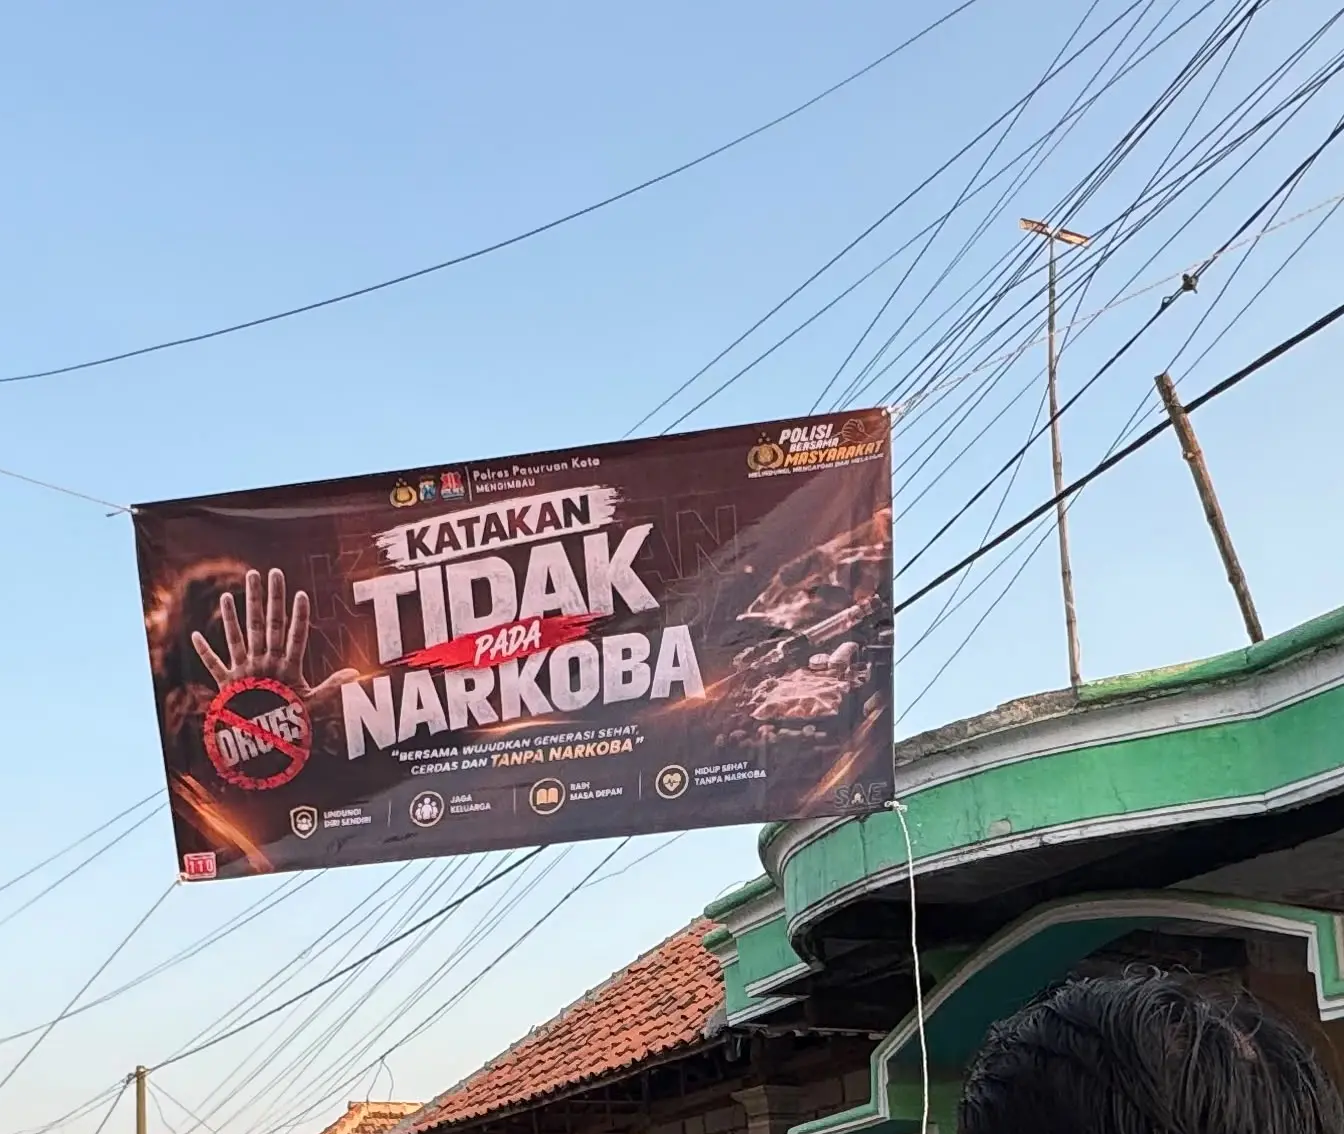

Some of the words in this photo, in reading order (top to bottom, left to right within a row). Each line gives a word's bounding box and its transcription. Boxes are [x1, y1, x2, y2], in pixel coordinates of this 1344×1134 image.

[779, 423, 834, 444] POLISI
[789, 437, 839, 452] BERSAMA
[784, 440, 884, 467] MASYARAKAT
[473, 466, 509, 482] Polres
[512, 461, 568, 476] Pasuruan
[571, 457, 601, 470] Kota
[476, 479, 536, 494] MENGIMBAU
[406, 495, 590, 560] KATAKAN
[353, 523, 660, 664] TIDAK
[474, 620, 542, 667] PADA
[341, 625, 706, 760] NARKOBA
[217, 702, 304, 767] DRUGS
[462, 740, 530, 755] WUJUDKAN
[534, 732, 595, 746] GENERASI
[411, 761, 458, 775] CERDAS
[461, 758, 487, 769] DAN
[491, 749, 544, 768] TANPA
[694, 774, 723, 786] TANPA
[724, 770, 767, 782] NARKOBA
[188, 858, 213, 874] 110
